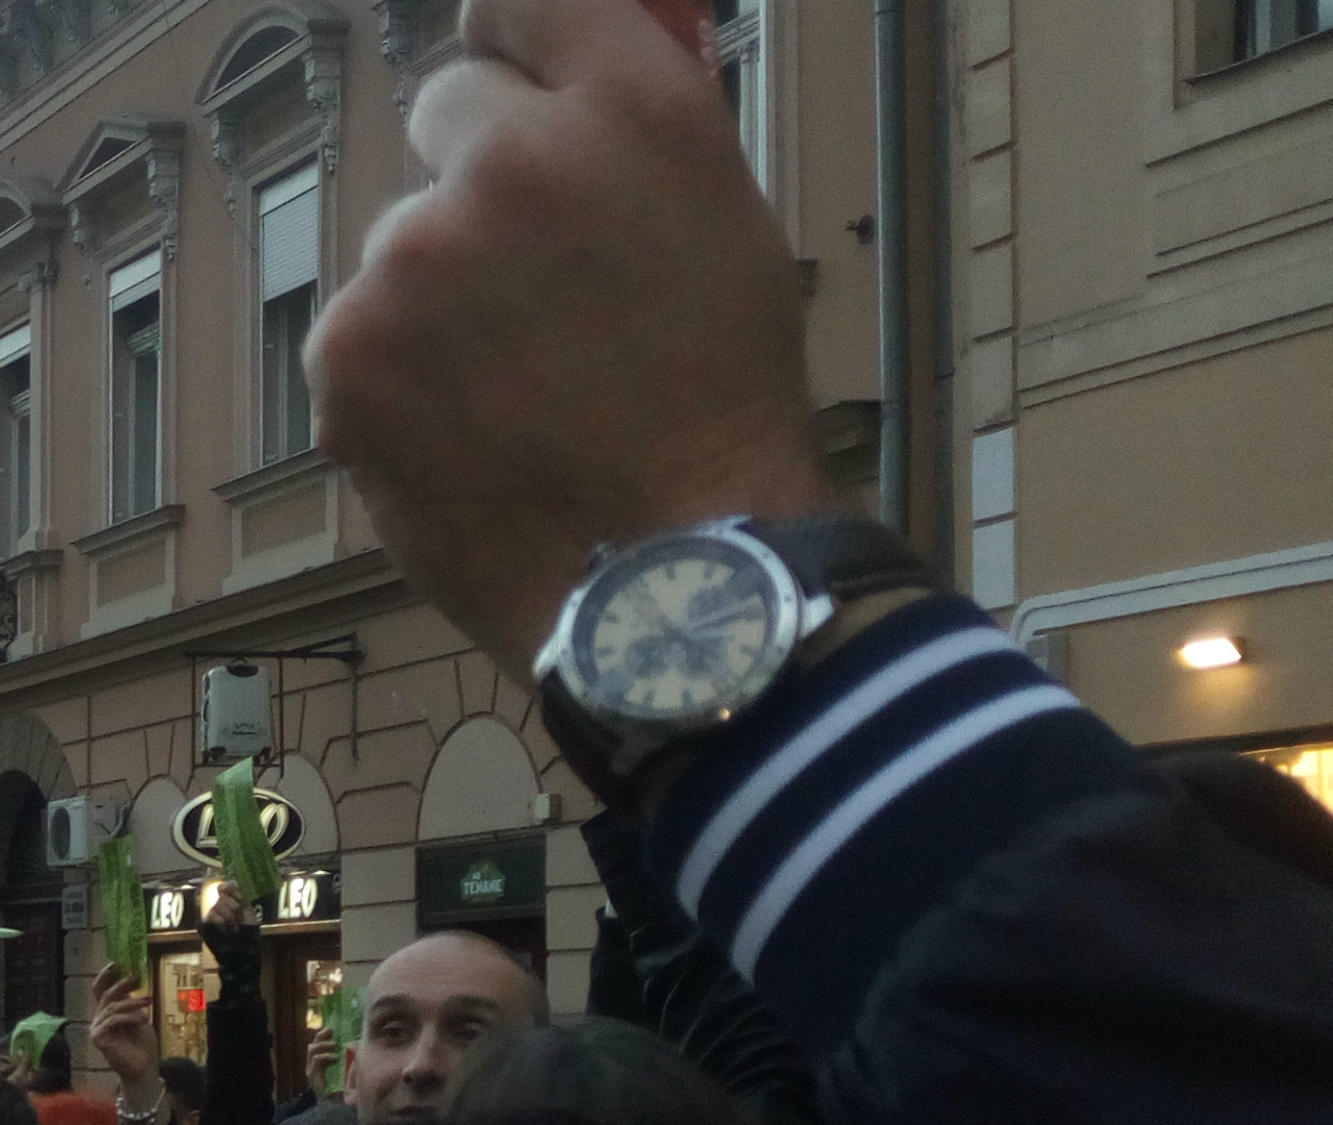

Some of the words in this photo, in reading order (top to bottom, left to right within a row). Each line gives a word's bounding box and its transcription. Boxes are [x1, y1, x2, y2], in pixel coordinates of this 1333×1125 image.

[195, 803, 290, 848] LO
[150, 891, 185, 929] LEO
[277, 877, 318, 919] LEO
